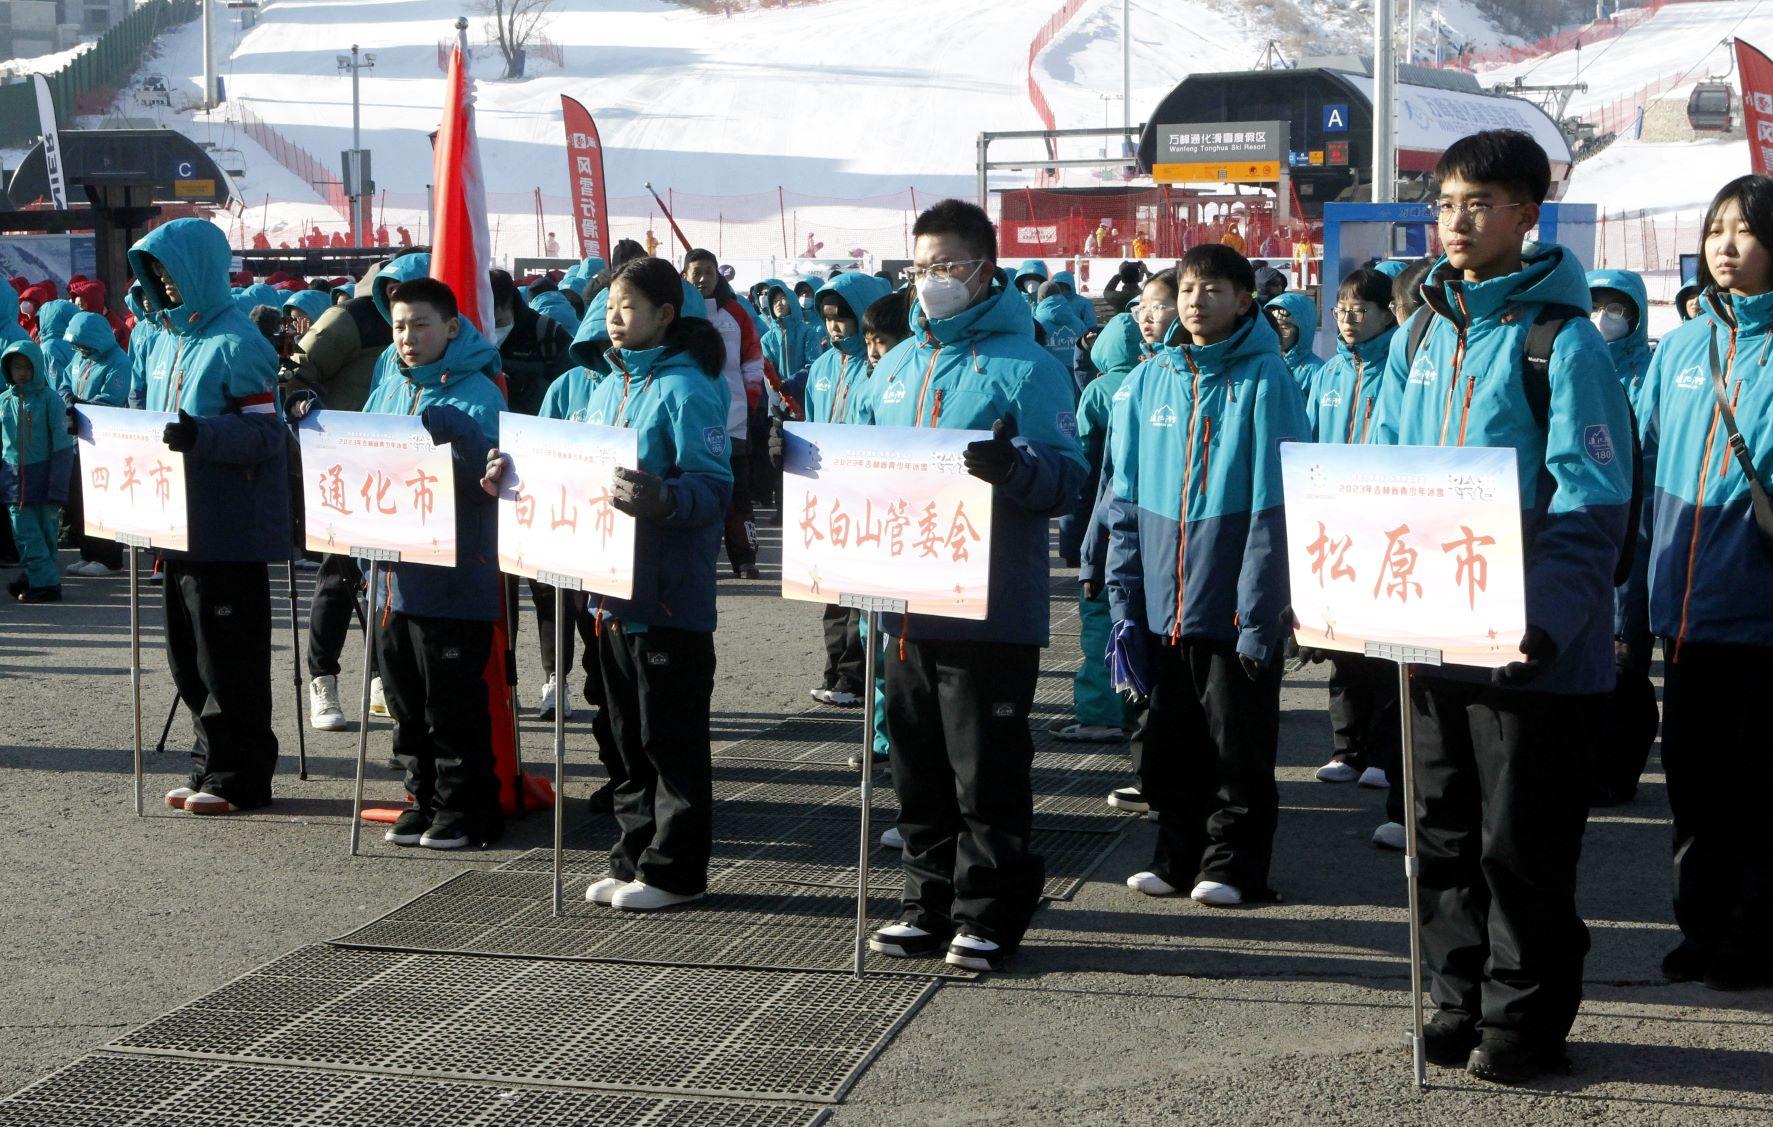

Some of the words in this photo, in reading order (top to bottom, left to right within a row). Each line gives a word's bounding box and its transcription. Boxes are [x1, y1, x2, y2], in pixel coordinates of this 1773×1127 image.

[1328, 109, 1343, 128] A
[178, 162, 192, 177] C
[1200, 145, 1229, 153] Tonghua
[1595, 450, 1611, 459] 180
[90, 455, 173, 512] 四平市
[318, 463, 438, 527] 通化市
[515, 480, 616, 552] 白山市
[799, 489, 981, 564] 长白山管委会
[1305, 520, 1496, 613] 松原市
